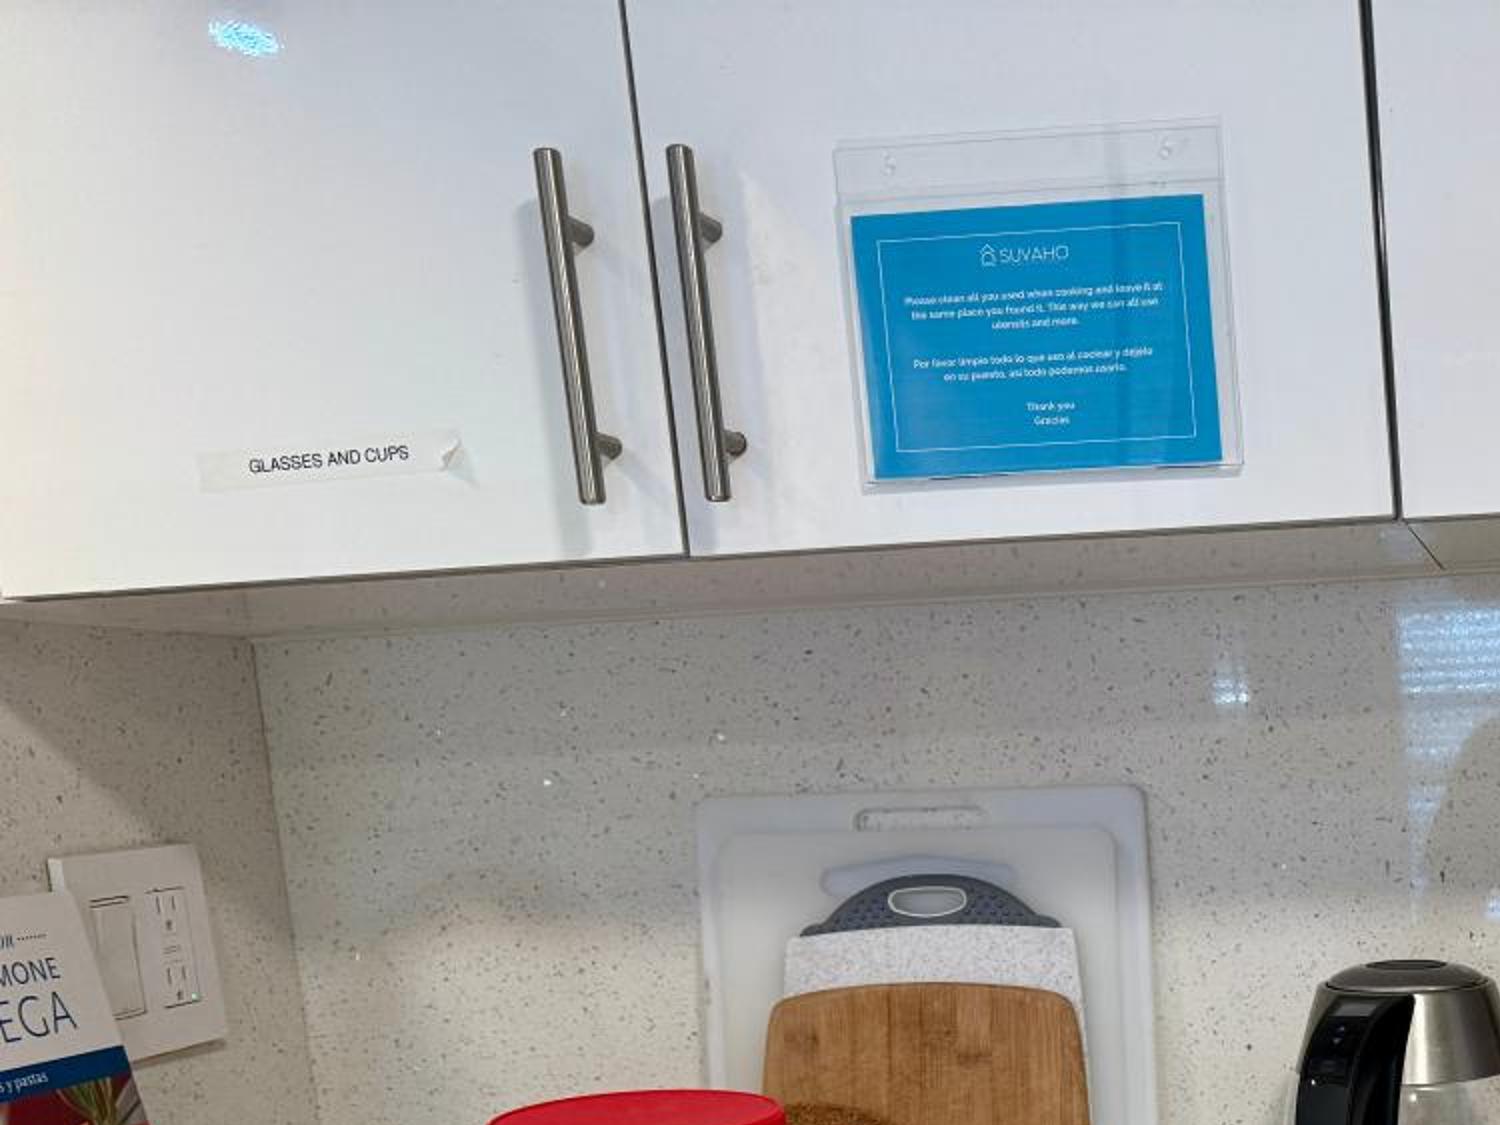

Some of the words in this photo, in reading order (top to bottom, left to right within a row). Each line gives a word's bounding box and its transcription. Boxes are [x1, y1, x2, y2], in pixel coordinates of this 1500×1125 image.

[999, 245, 1069, 263] SUVAHO
[904, 295, 936, 306] Please
[938, 293, 965, 304] clean
[966, 292, 979, 302] all
[981, 293, 999, 304] you
[1001, 290, 1025, 301] used
[1027, 288, 1053, 299] when
[1055, 286, 1093, 297] cooking
[1096, 284, 1114, 294] and
[1116, 283, 1142, 293] leave
[911, 310, 927, 320] the
[929, 310, 955, 320] same
[957, 307, 984, 320] place
[986, 306, 1003, 317] you
[1005, 303, 1034, 315] found
[1069, 302, 1089, 312] way
[1090, 300, 1105, 310] we
[1106, 299, 1125, 309] can
[1126, 297, 1139, 307] all
[1031, 317, 1051, 328] and
[913, 357, 930, 369] Por
[931, 356, 956, 368] favor
[990, 353, 1014, 365] todo
[1014, 353, 1025, 364] lo
[1026, 354, 1046, 365] que
[1078, 349, 1113, 360] cocinar
[943, 373, 957, 381] en
[958, 372, 970, 381] su
[1047, 365, 1094, 378] podemos
[1025, 400, 1056, 412] Thank
[1056, 401, 1076, 413] you
[1032, 415, 1072, 426] Gracias
[248, 452, 324, 474] GLASSES
[326, 448, 362, 468] AND
[364, 444, 410, 463] CUPS
[14, 1071, 49, 1095] pastas
